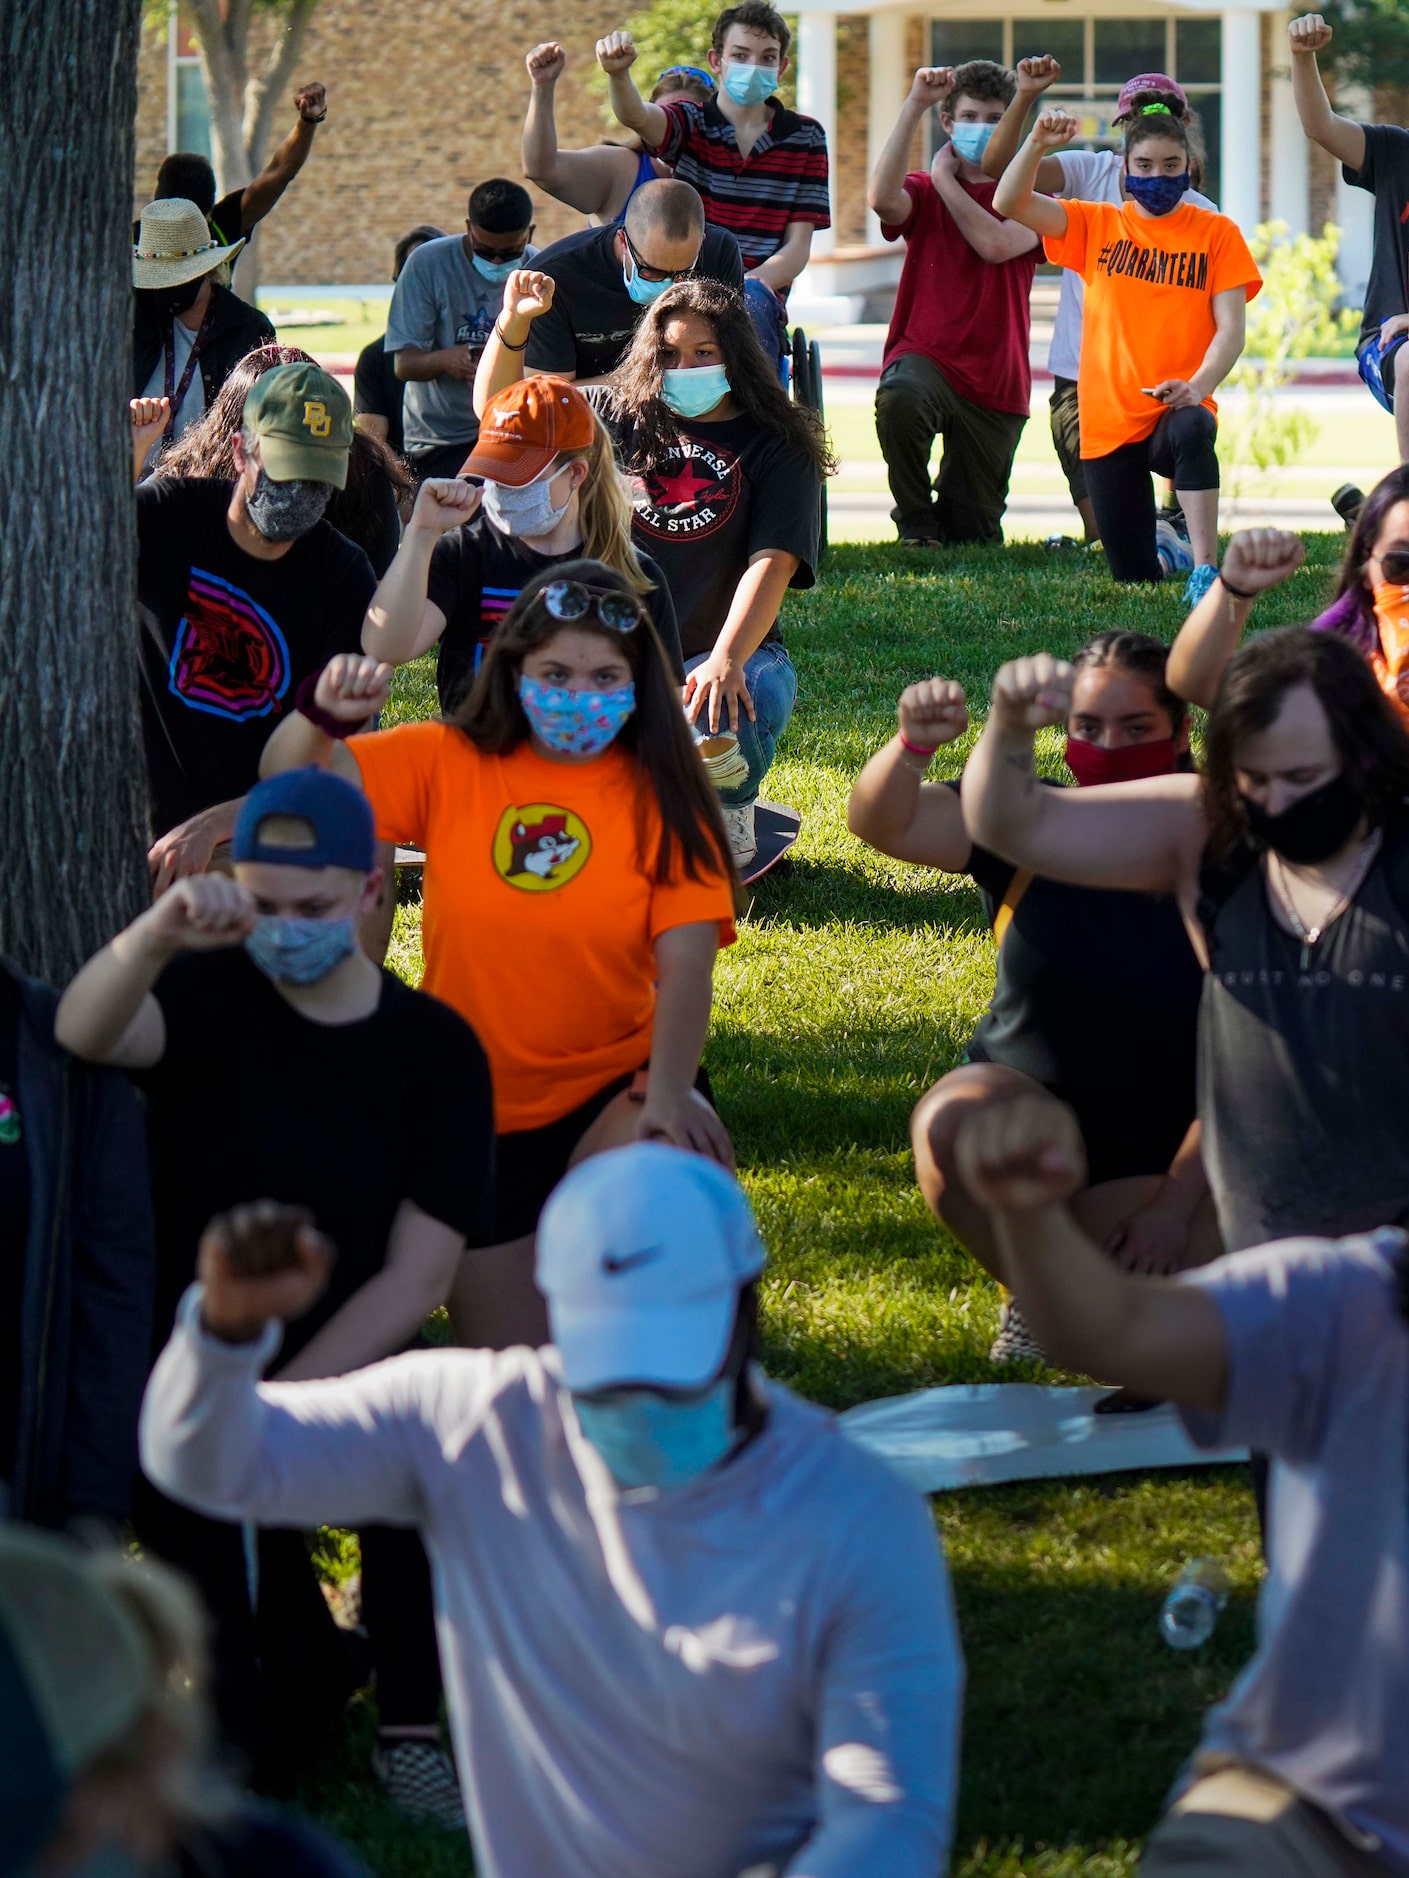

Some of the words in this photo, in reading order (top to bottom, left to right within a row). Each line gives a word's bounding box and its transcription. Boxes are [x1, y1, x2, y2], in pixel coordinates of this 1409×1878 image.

[1097, 238, 1209, 292] #QUARANTEAM
[302, 400, 332, 438] BU
[667, 443, 731, 481] NVERSE
[667, 507, 717, 532] STAR
[1298, 970, 1332, 988] NO
[1347, 969, 1405, 993] ONE
